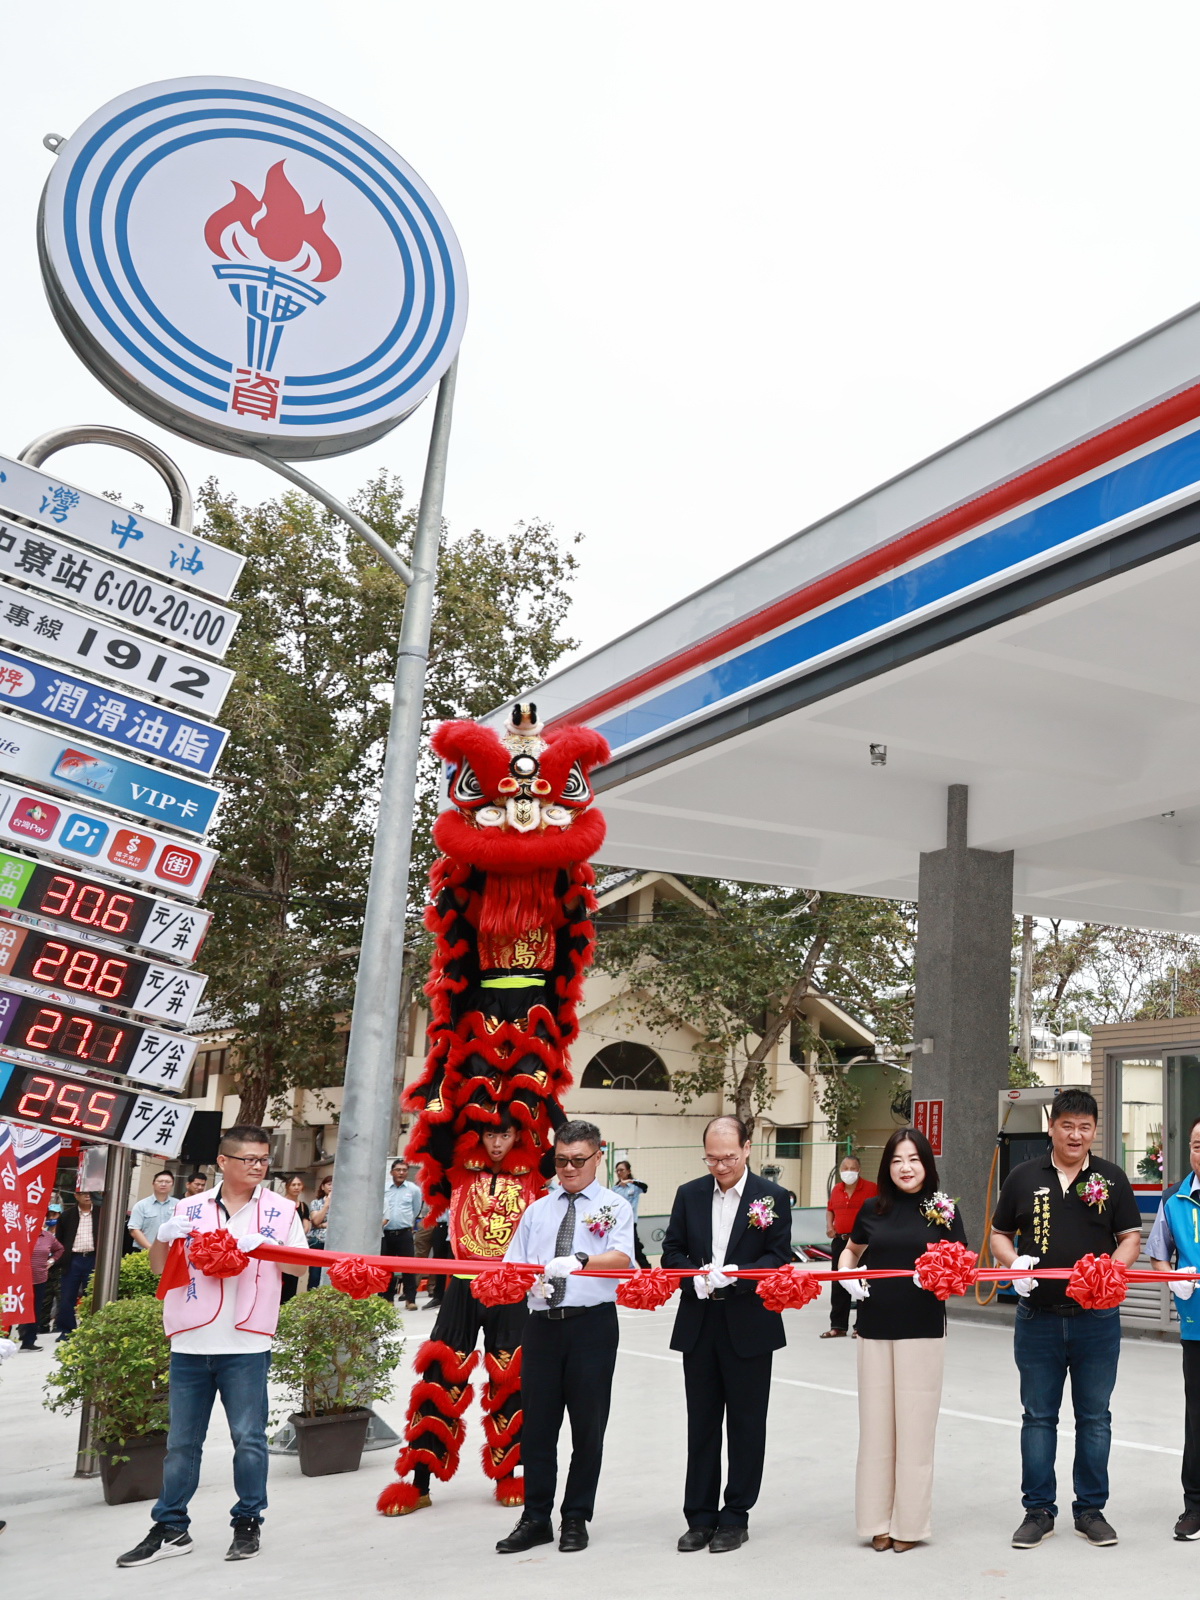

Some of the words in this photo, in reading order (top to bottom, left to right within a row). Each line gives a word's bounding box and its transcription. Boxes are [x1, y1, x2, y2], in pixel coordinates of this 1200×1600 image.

[231, 367, 280, 421] 資
[0, 471, 204, 575] 灣中油
[94, 570, 225, 646] 6:00-20:00
[0, 600, 63, 641] 專線
[77, 627, 210, 699] 1912
[0, 738, 20, 754] ife
[41, 678, 210, 765] 潤滑油脂
[130, 782, 199, 818] VIP卡
[66, 820, 99, 847] Pi
[40, 875, 134, 933] 30.6
[32, 942, 128, 998] 28.6
[26, 1009, 125, 1063] 27.1
[18, 1076, 117, 1132] 25.5
